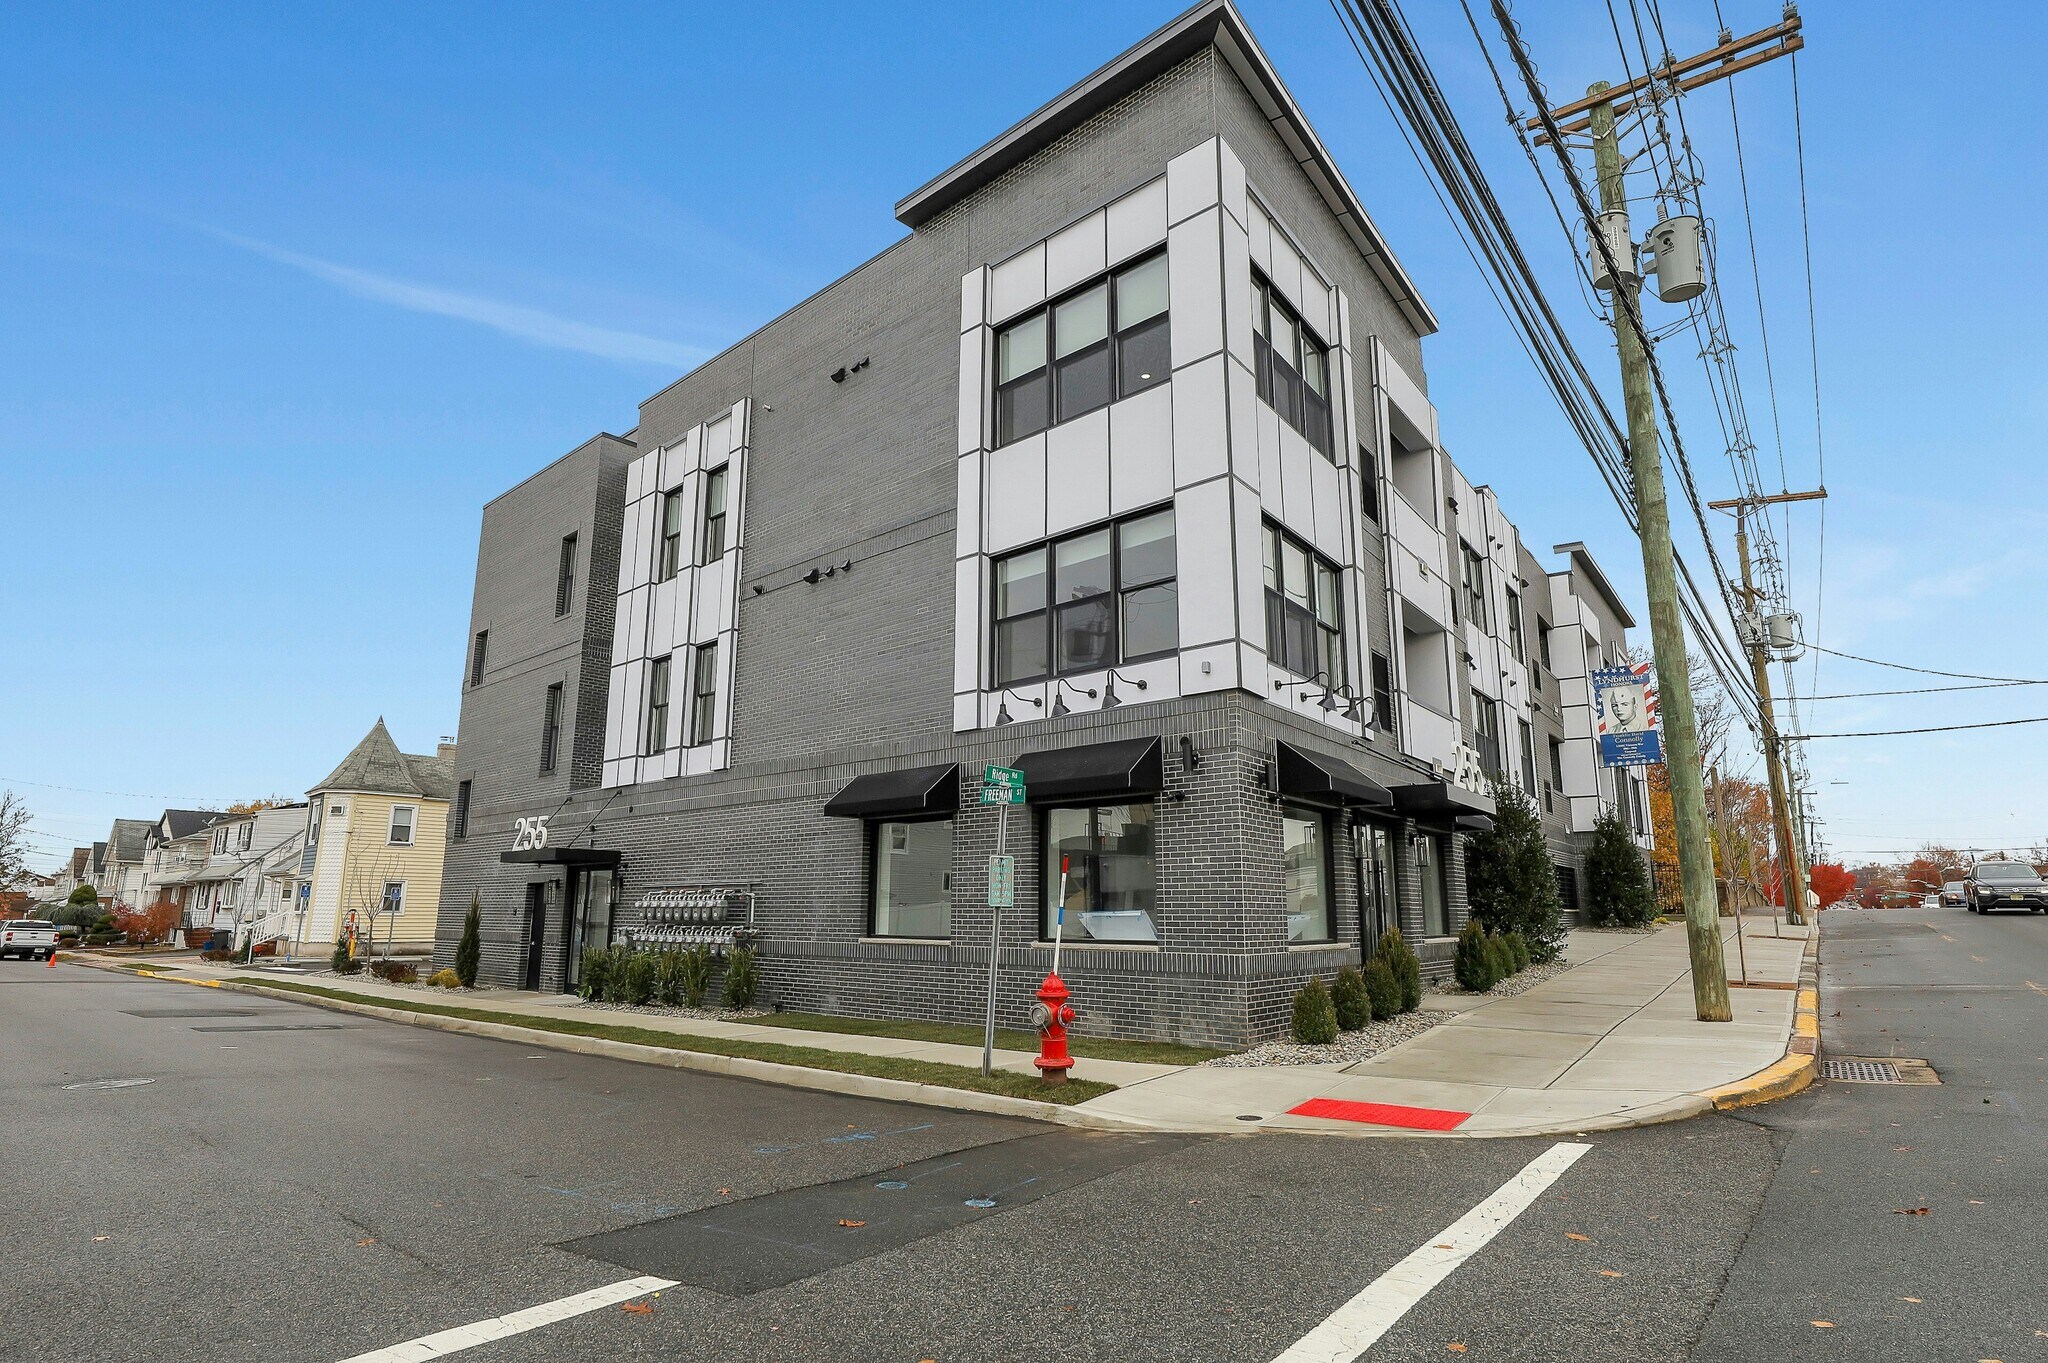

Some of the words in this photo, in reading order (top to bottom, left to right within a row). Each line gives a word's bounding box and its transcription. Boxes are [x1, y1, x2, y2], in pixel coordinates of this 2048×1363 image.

[1614, 736, 1644, 744] Connolly
[991, 768, 1009, 782] Ridge
[1450, 741, 1485, 796] 255
[984, 788, 1013, 801] FREEMAN
[1016, 788, 1023, 796] ST
[512, 815, 549, 852] 255
